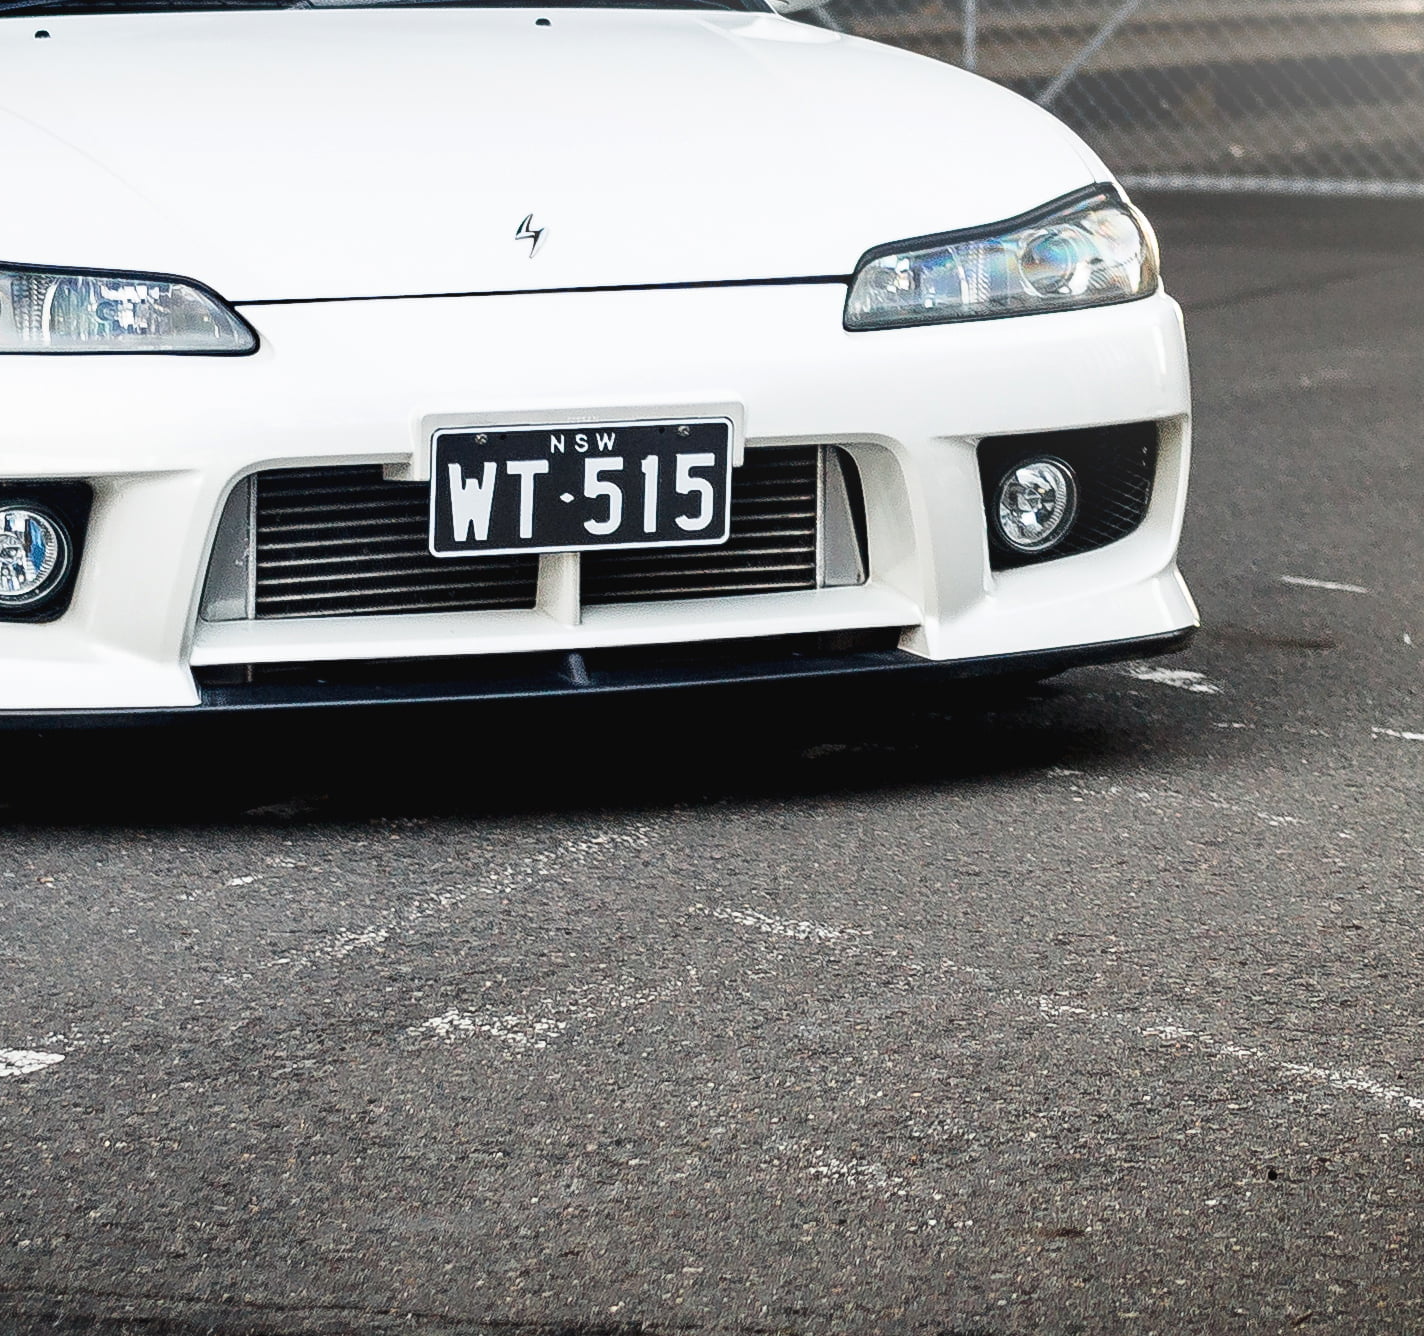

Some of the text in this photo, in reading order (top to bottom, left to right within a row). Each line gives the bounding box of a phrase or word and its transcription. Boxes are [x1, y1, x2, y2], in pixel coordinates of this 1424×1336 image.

[550, 431, 616, 454] NSW
[448, 452, 716, 543] WT 515
